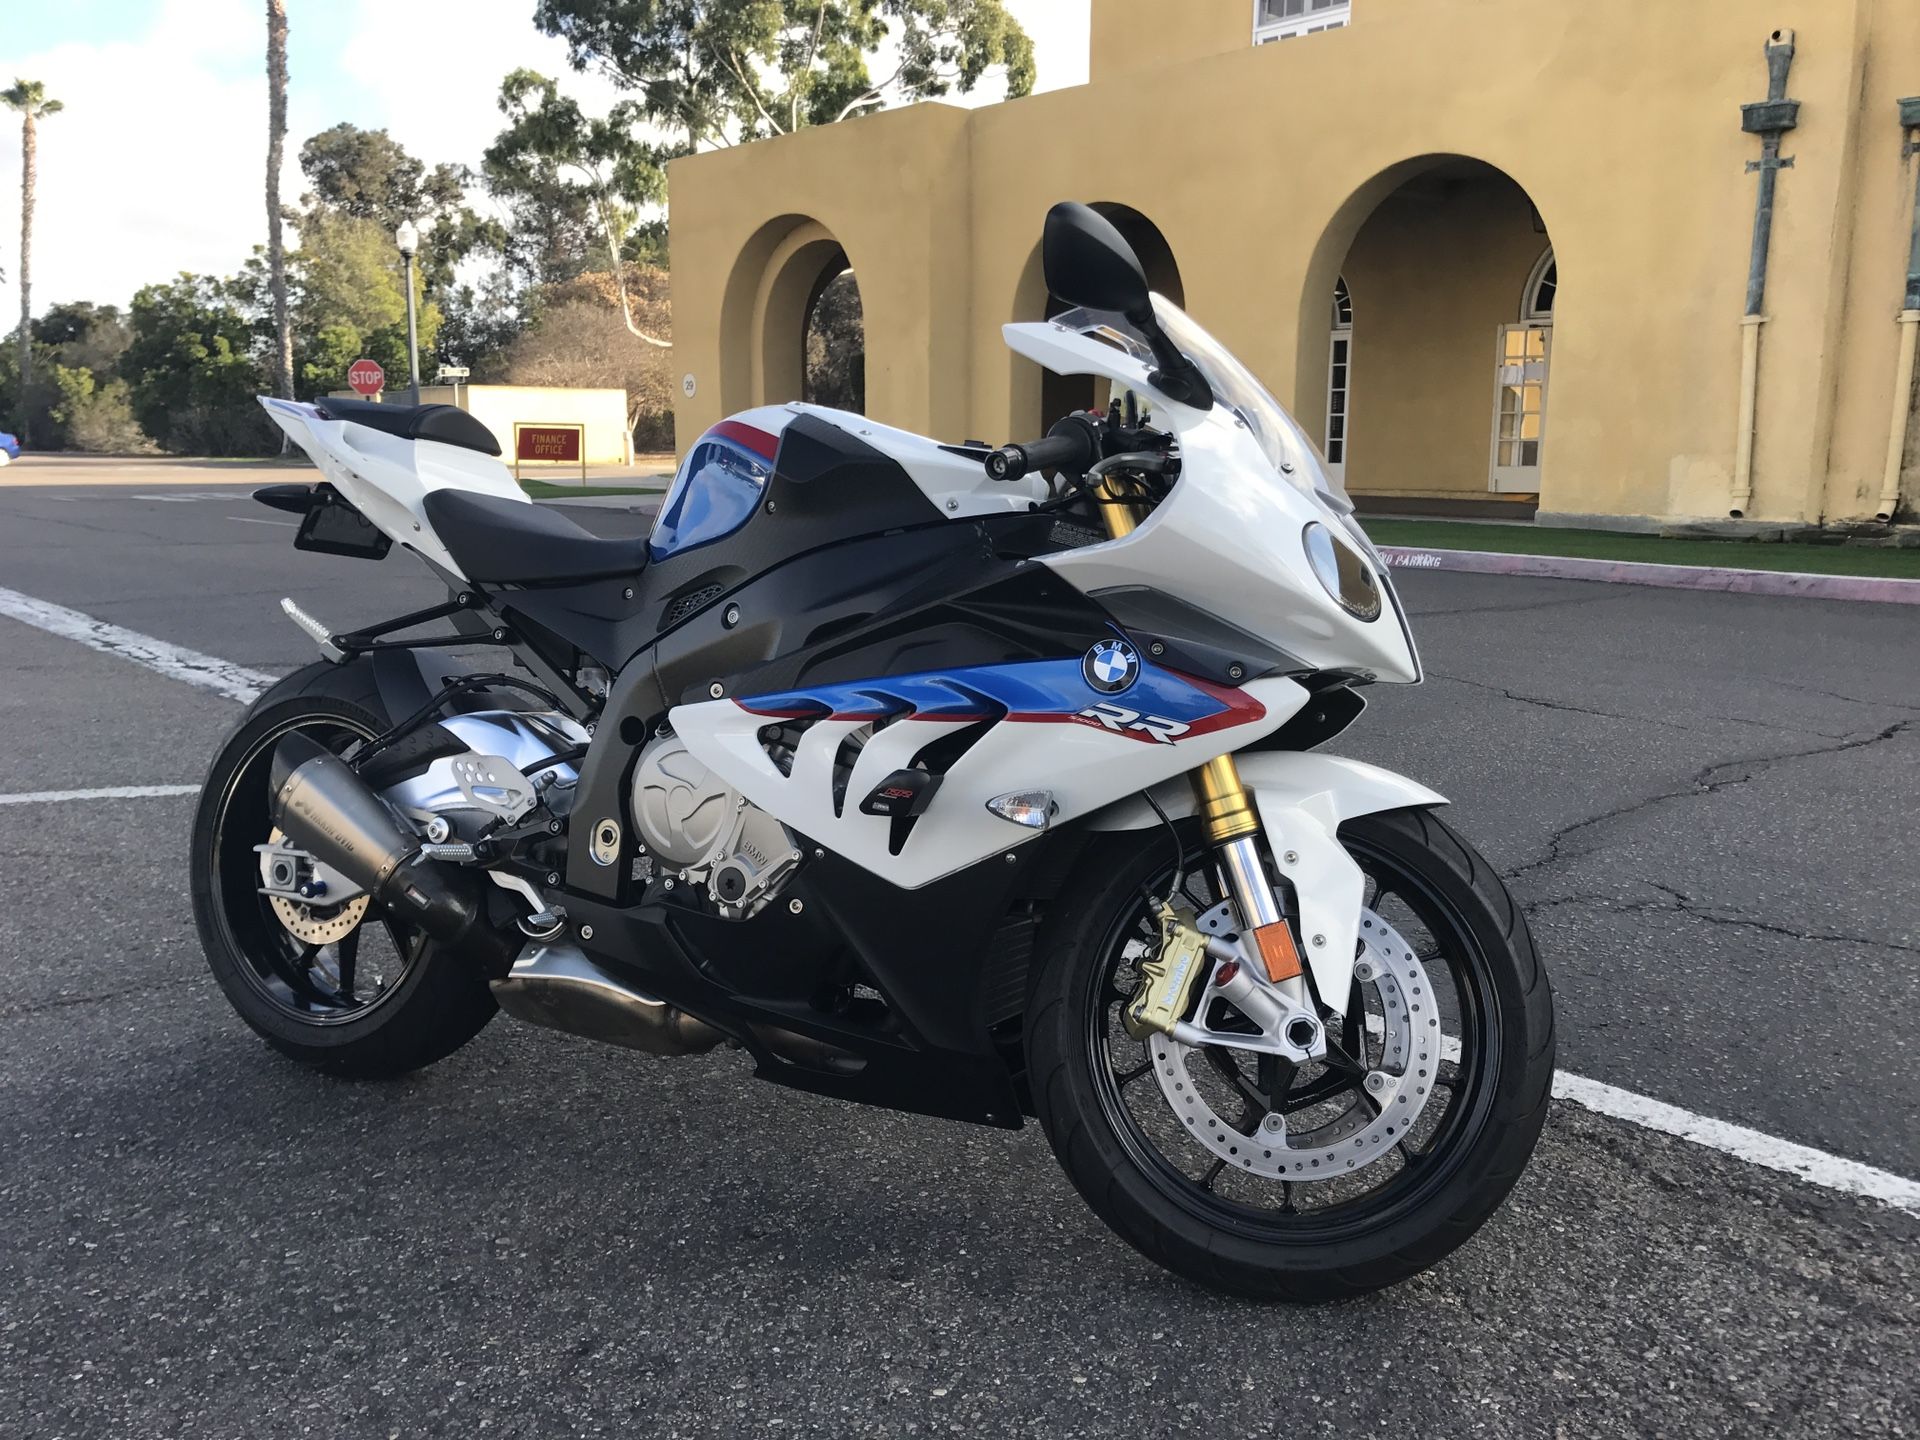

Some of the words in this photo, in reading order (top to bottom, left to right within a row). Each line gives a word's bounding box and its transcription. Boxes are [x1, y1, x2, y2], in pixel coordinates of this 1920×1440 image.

[351, 371, 381, 385] STOP
[685, 380, 694, 391] 29
[531, 433, 567, 445] FINANCE
[534, 445, 563, 455] OFFICE
[1395, 553, 1442, 567] PARKING
[1093, 641, 1136, 664] BMW
[1078, 702, 1191, 746] RR
[743, 840, 768, 866] BMW
